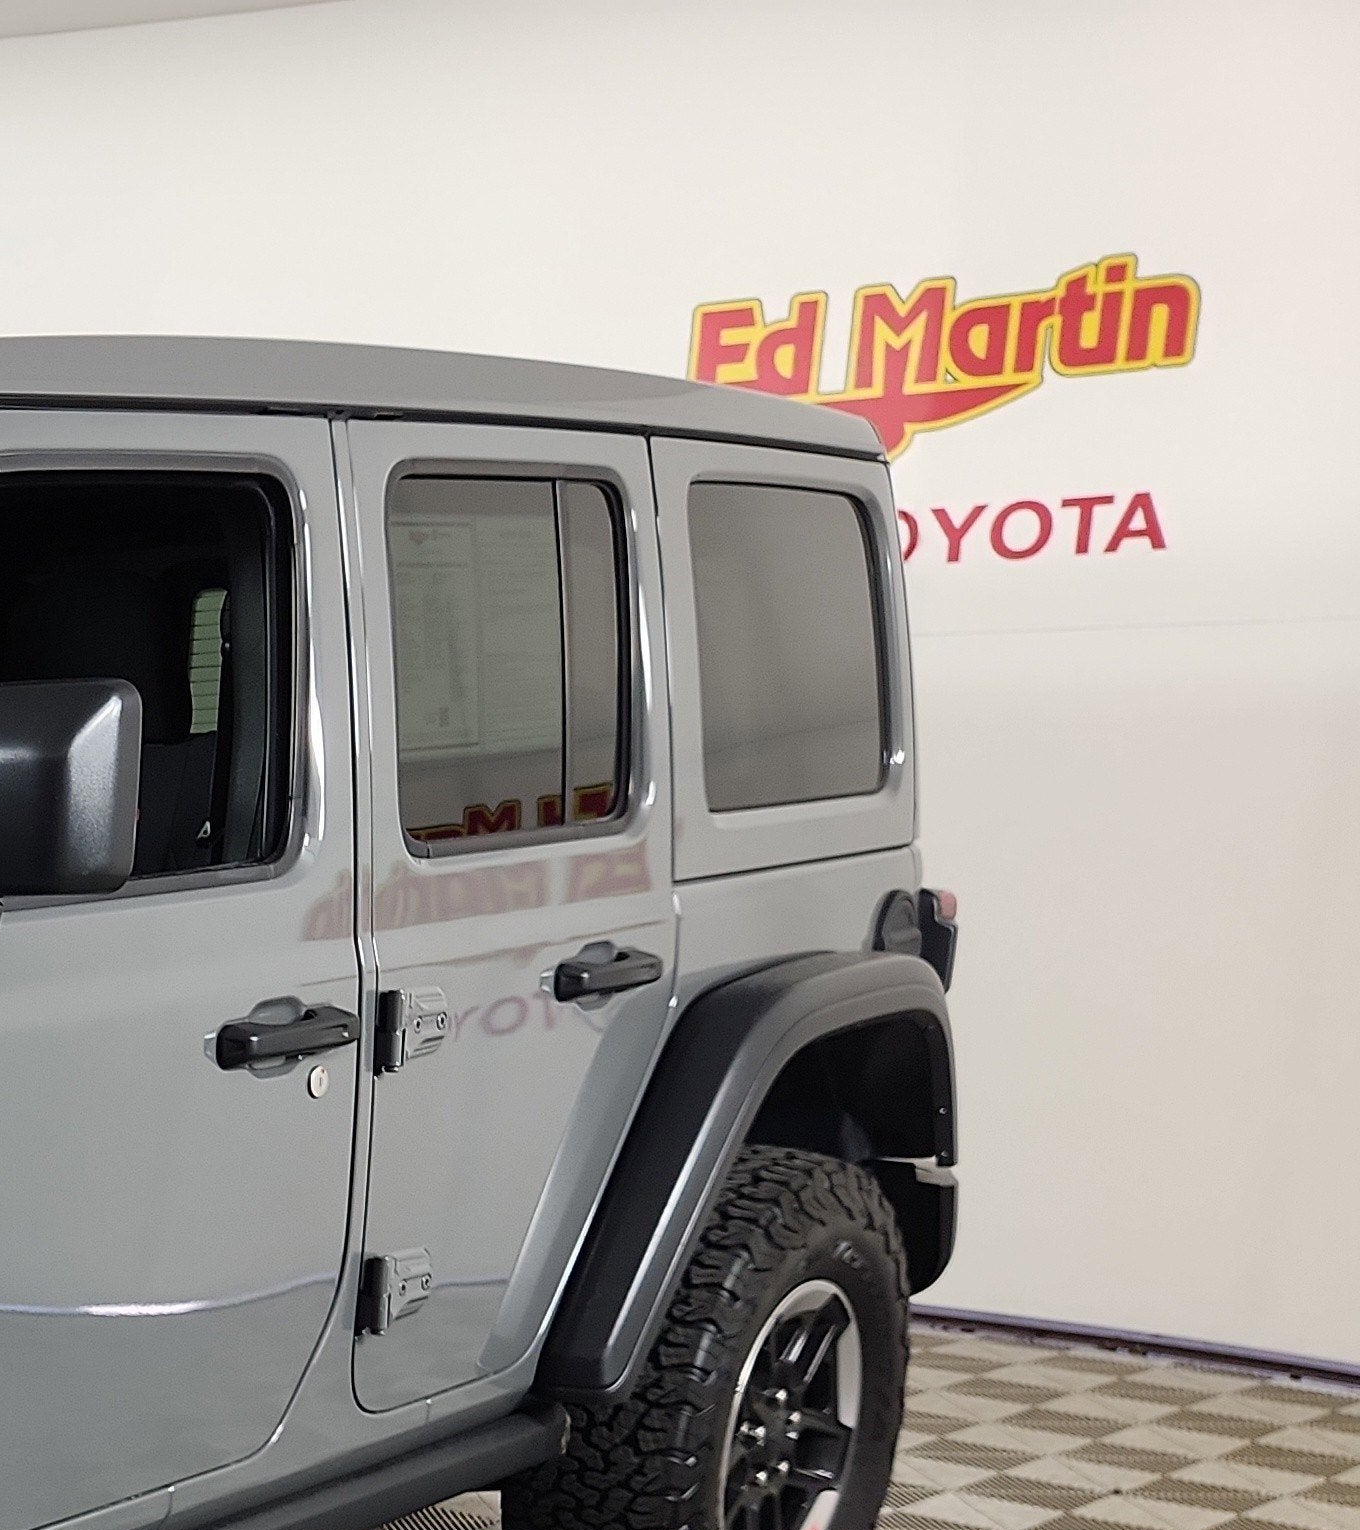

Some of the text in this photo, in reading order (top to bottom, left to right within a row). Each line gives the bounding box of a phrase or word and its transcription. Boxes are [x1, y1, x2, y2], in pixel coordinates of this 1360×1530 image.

[687, 252, 1202, 400] Ed Martin
[897, 492, 1167, 564] YOTA
